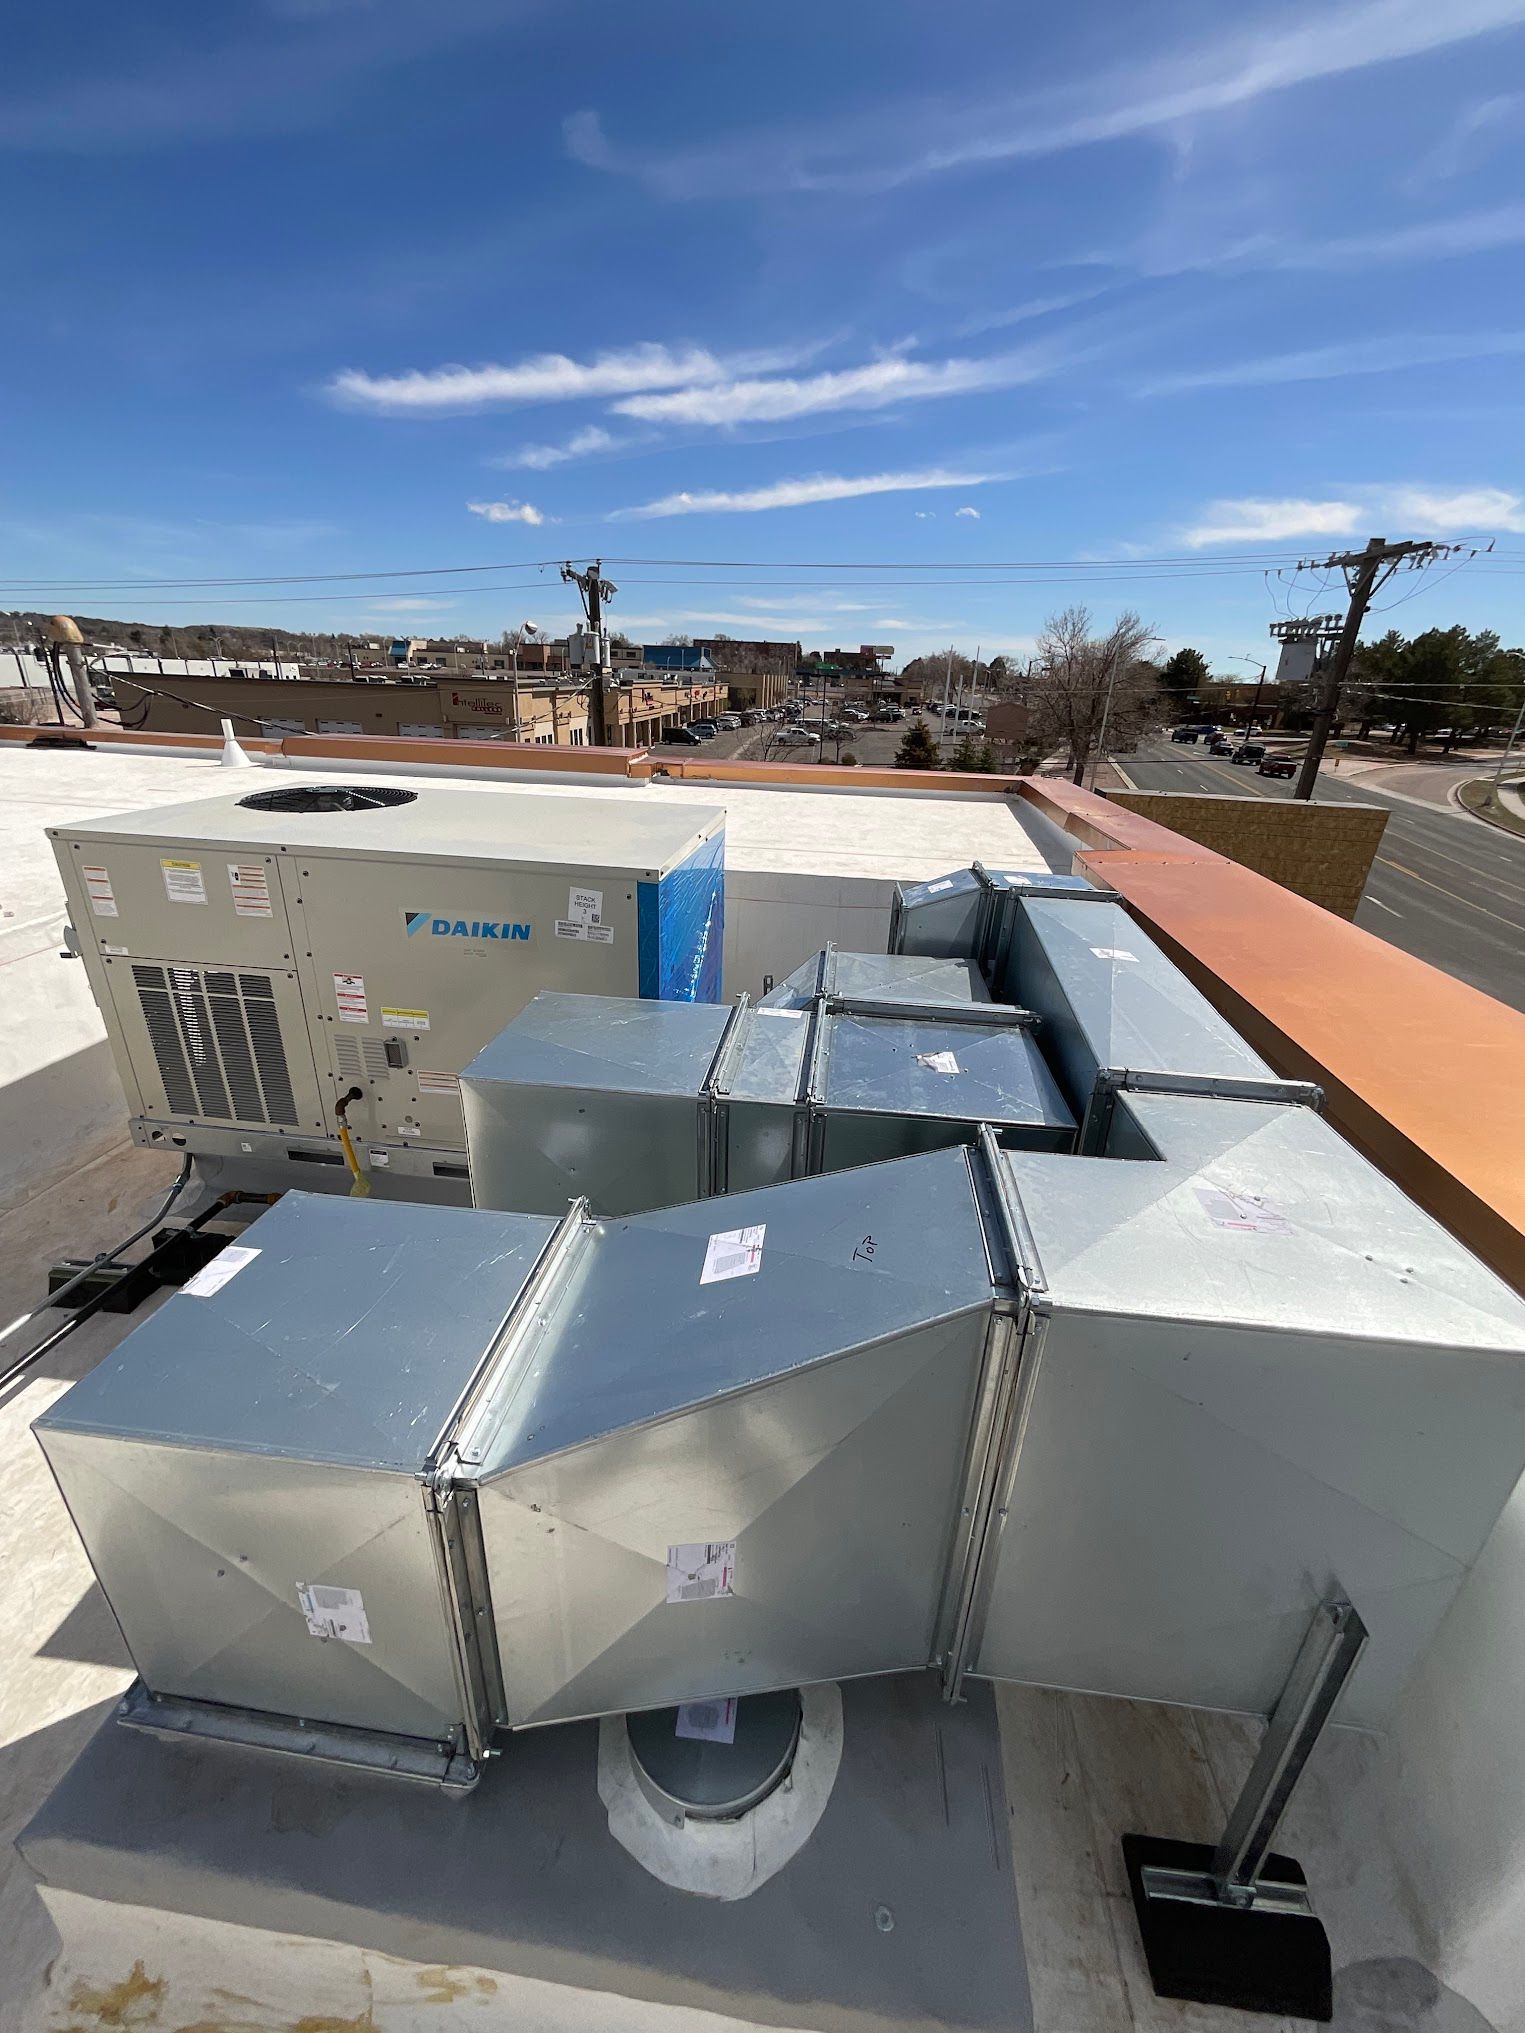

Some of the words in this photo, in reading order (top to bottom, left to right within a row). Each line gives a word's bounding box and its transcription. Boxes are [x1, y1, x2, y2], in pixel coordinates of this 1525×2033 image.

[575, 894, 597, 903] STACK
[574, 901, 597, 910] HEIGHT
[431, 919, 531, 941] DAIKIN
